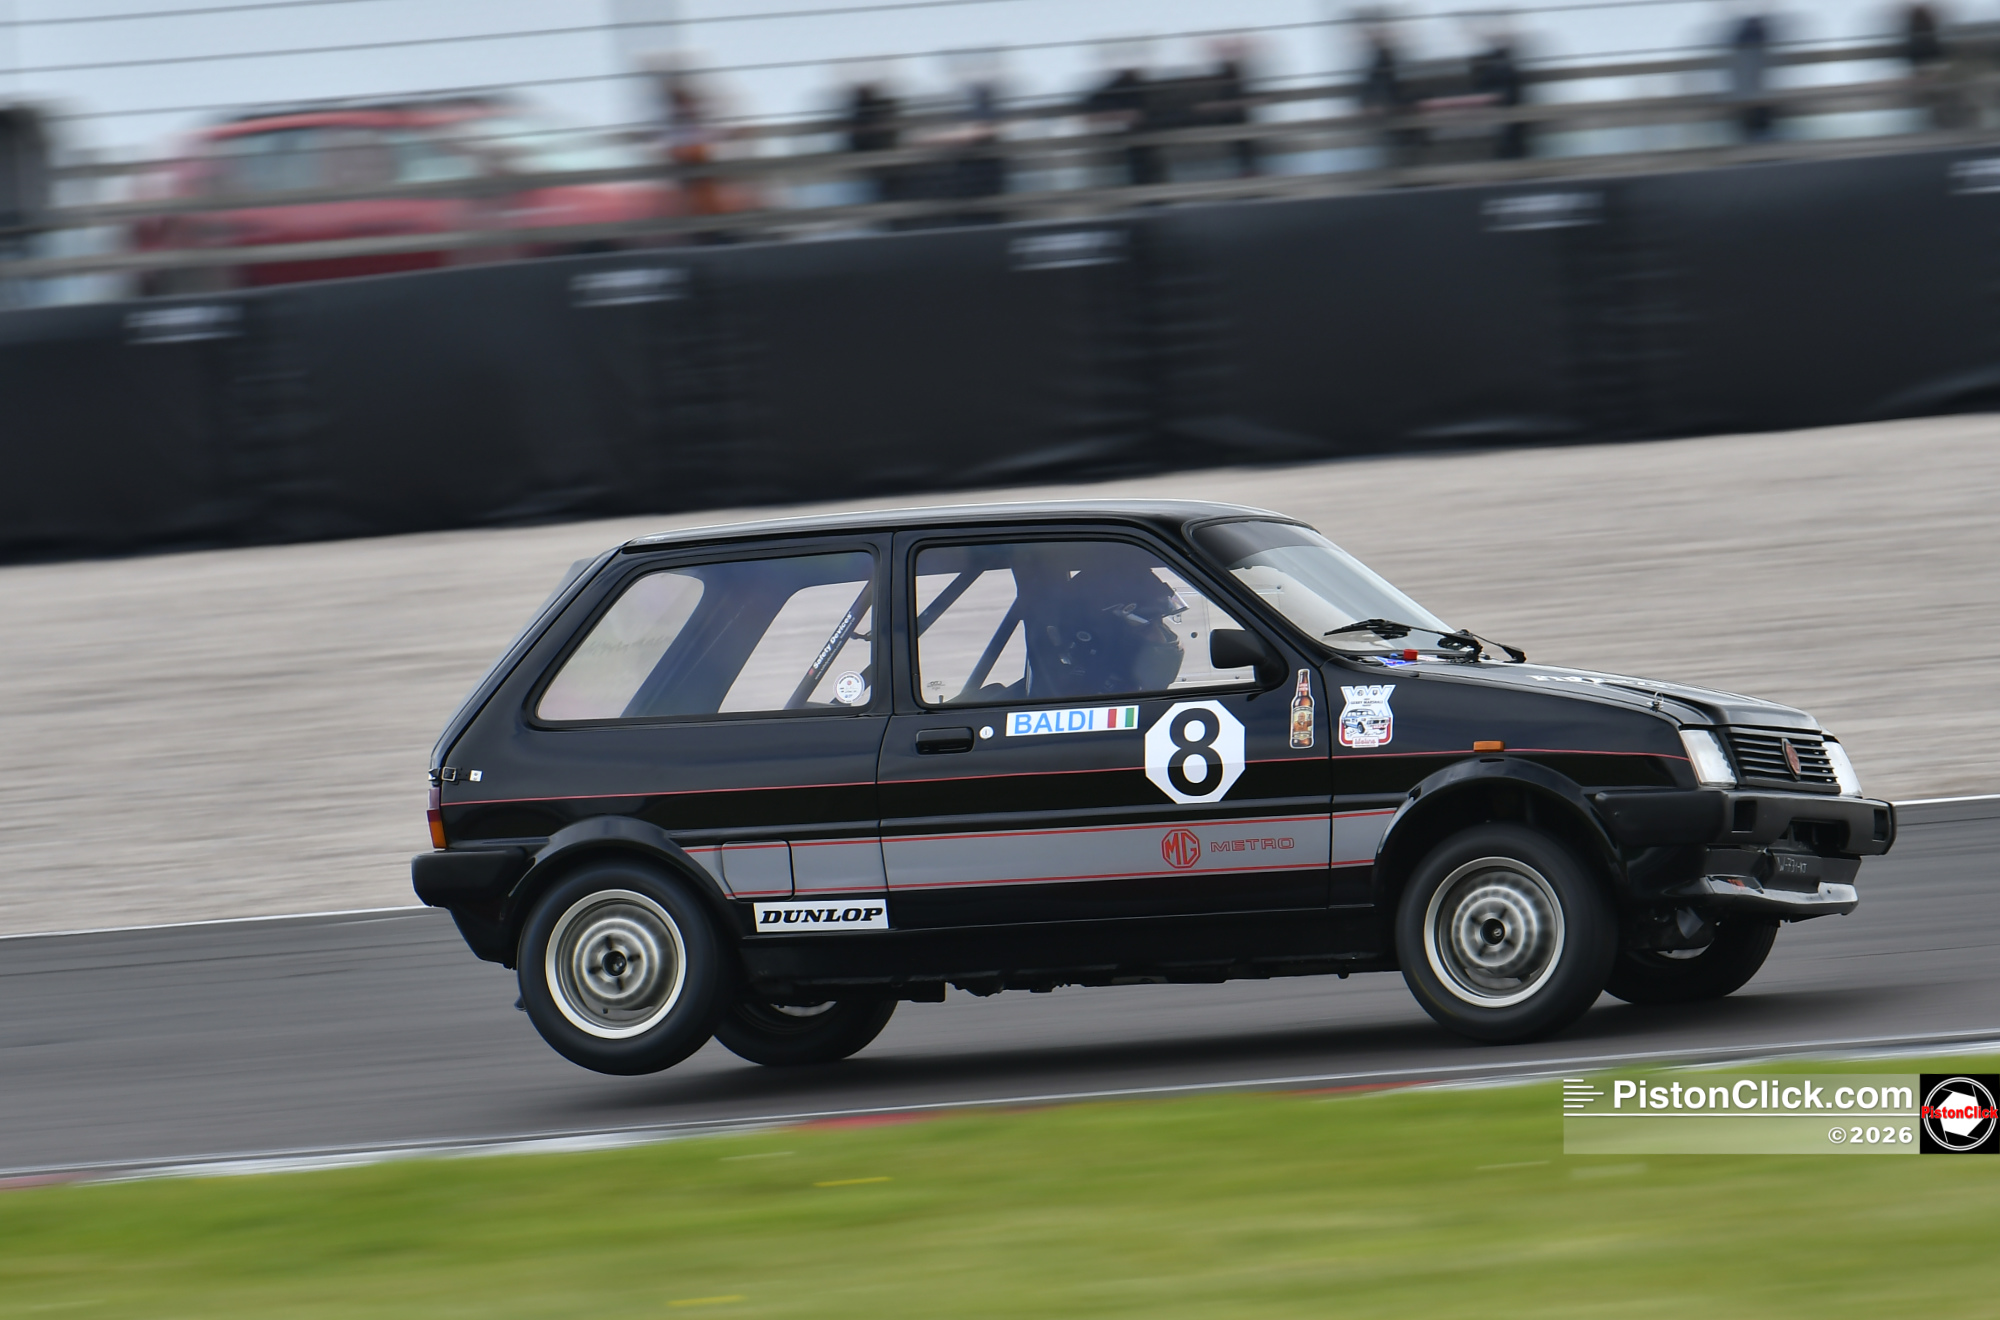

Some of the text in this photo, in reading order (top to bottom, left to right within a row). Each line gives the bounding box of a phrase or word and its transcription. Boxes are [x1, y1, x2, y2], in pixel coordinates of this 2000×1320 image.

[813, 613, 852, 669] Safety Devices
[1014, 709, 1094, 734] BALDI
[1167, 707, 1223, 797] 8
[1164, 831, 1295, 866] MG METRO
[760, 907, 883, 923] DUNLOP
